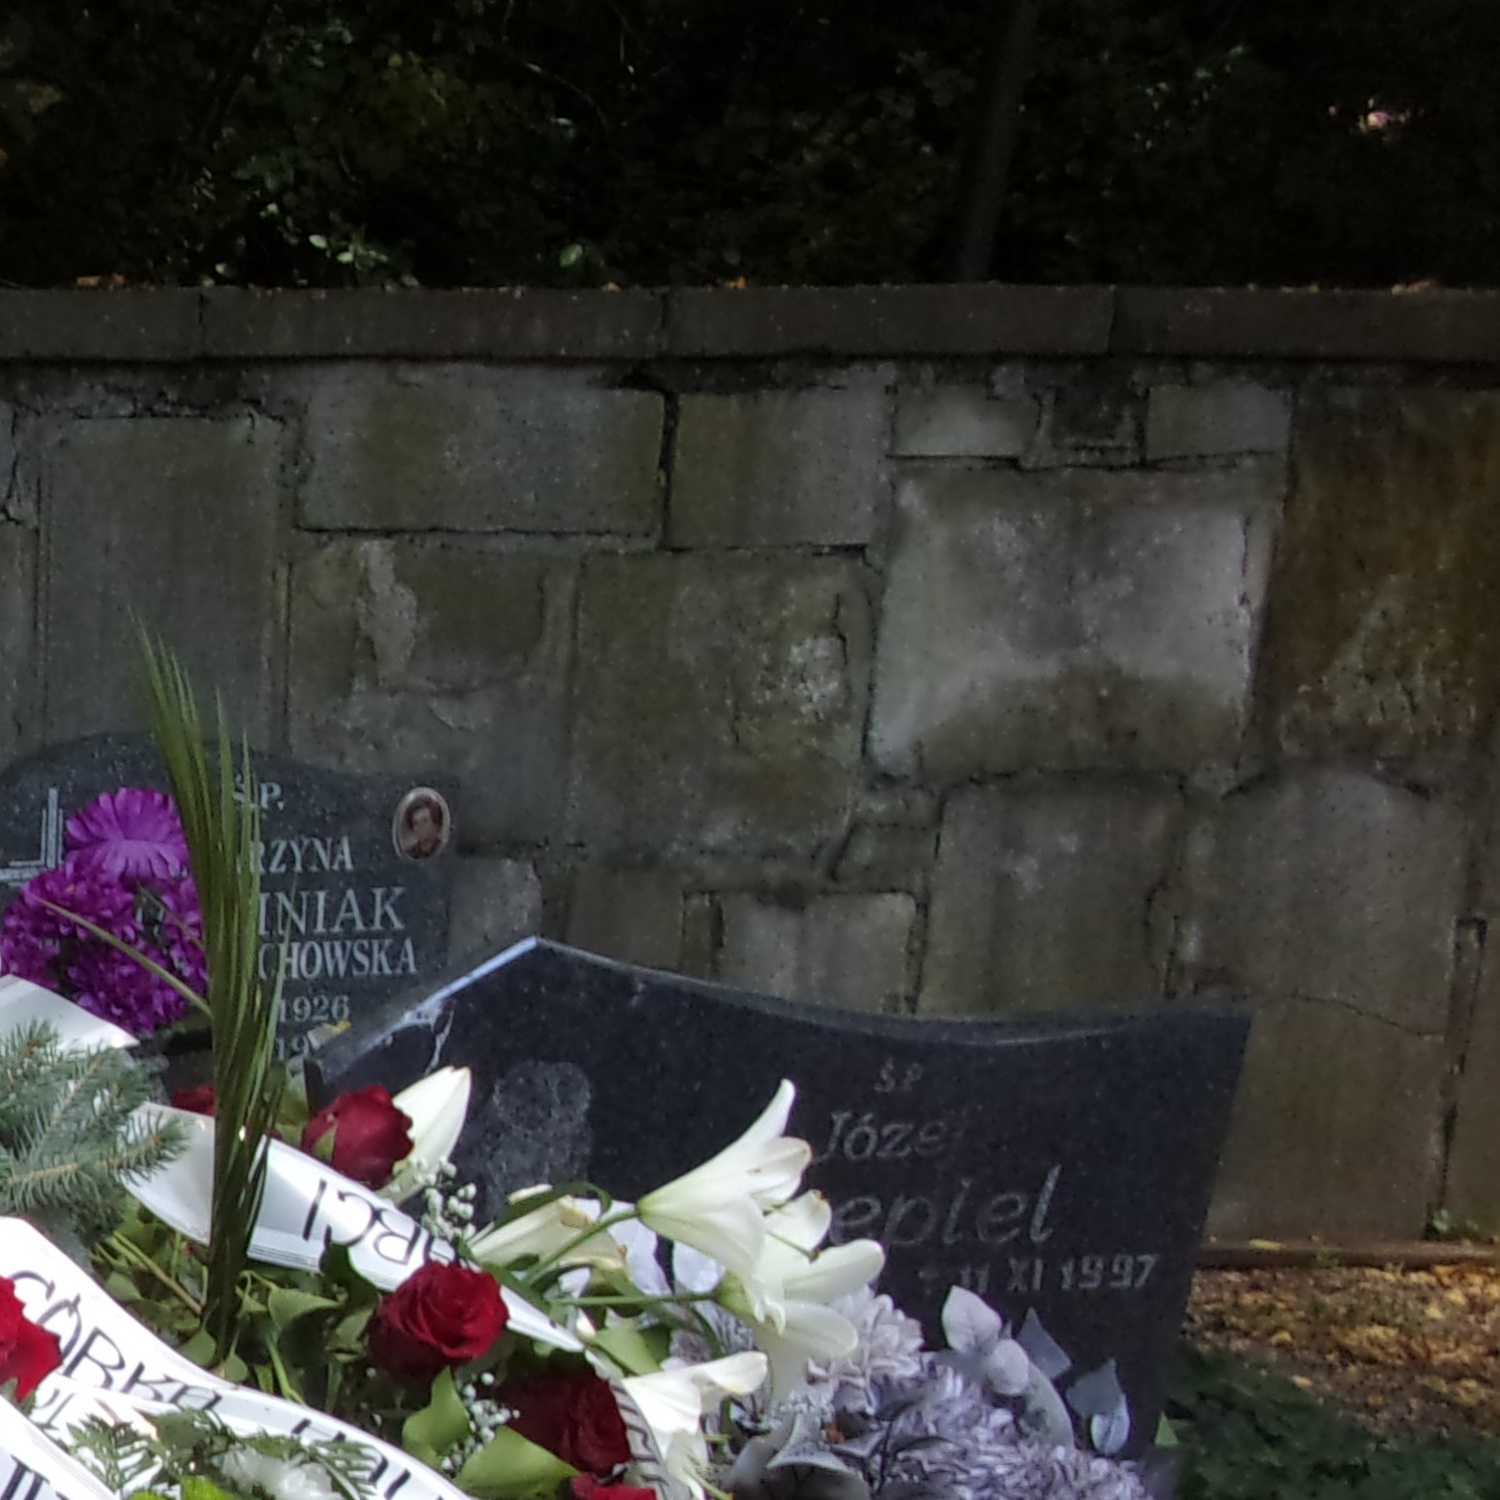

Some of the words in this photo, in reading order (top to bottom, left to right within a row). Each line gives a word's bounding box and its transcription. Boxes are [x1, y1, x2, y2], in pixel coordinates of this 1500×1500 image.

[239, 836, 354, 875] RZYNA
[258, 886, 407, 938] INIAK
[258, 938, 419, 981] CHOWSKA
[827, 1163, 1064, 1248] epiel
